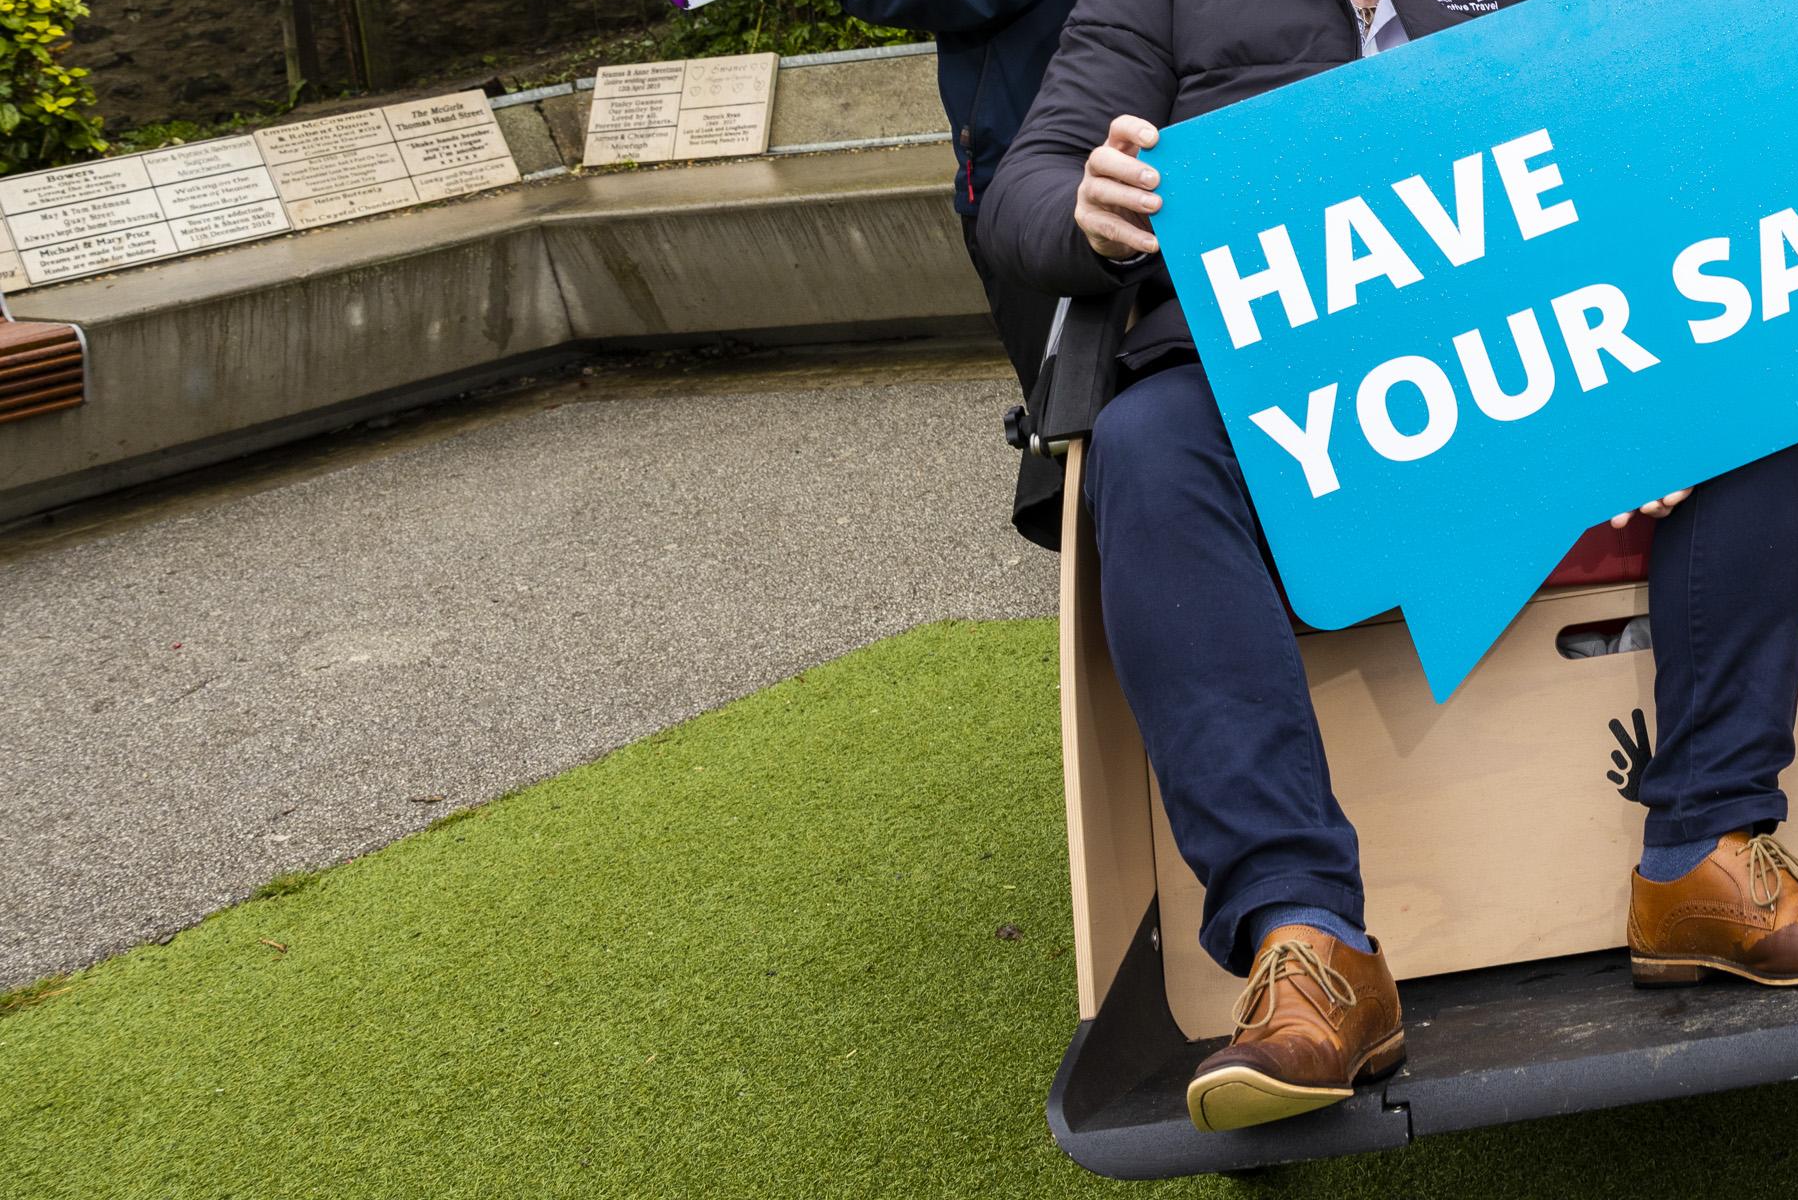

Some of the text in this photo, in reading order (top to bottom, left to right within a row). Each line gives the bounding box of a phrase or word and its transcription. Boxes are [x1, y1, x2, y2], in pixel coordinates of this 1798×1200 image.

[1469, 1, 1499, 11] Travel
[396, 109, 484, 131] Thomas Hand Street
[411, 110, 428, 119] The
[46, 170, 94, 183] Bowers
[71, 207, 90, 215] Tom
[63, 211, 115, 227] Quay Street
[24, 233, 55, 243] Always
[39, 243, 79, 258] Michael
[96, 237, 122, 246] Mary
[125, 231, 150, 240] Price
[1201, 129, 1578, 349] HAVE
[1249, 284, 1661, 498] YOUR
